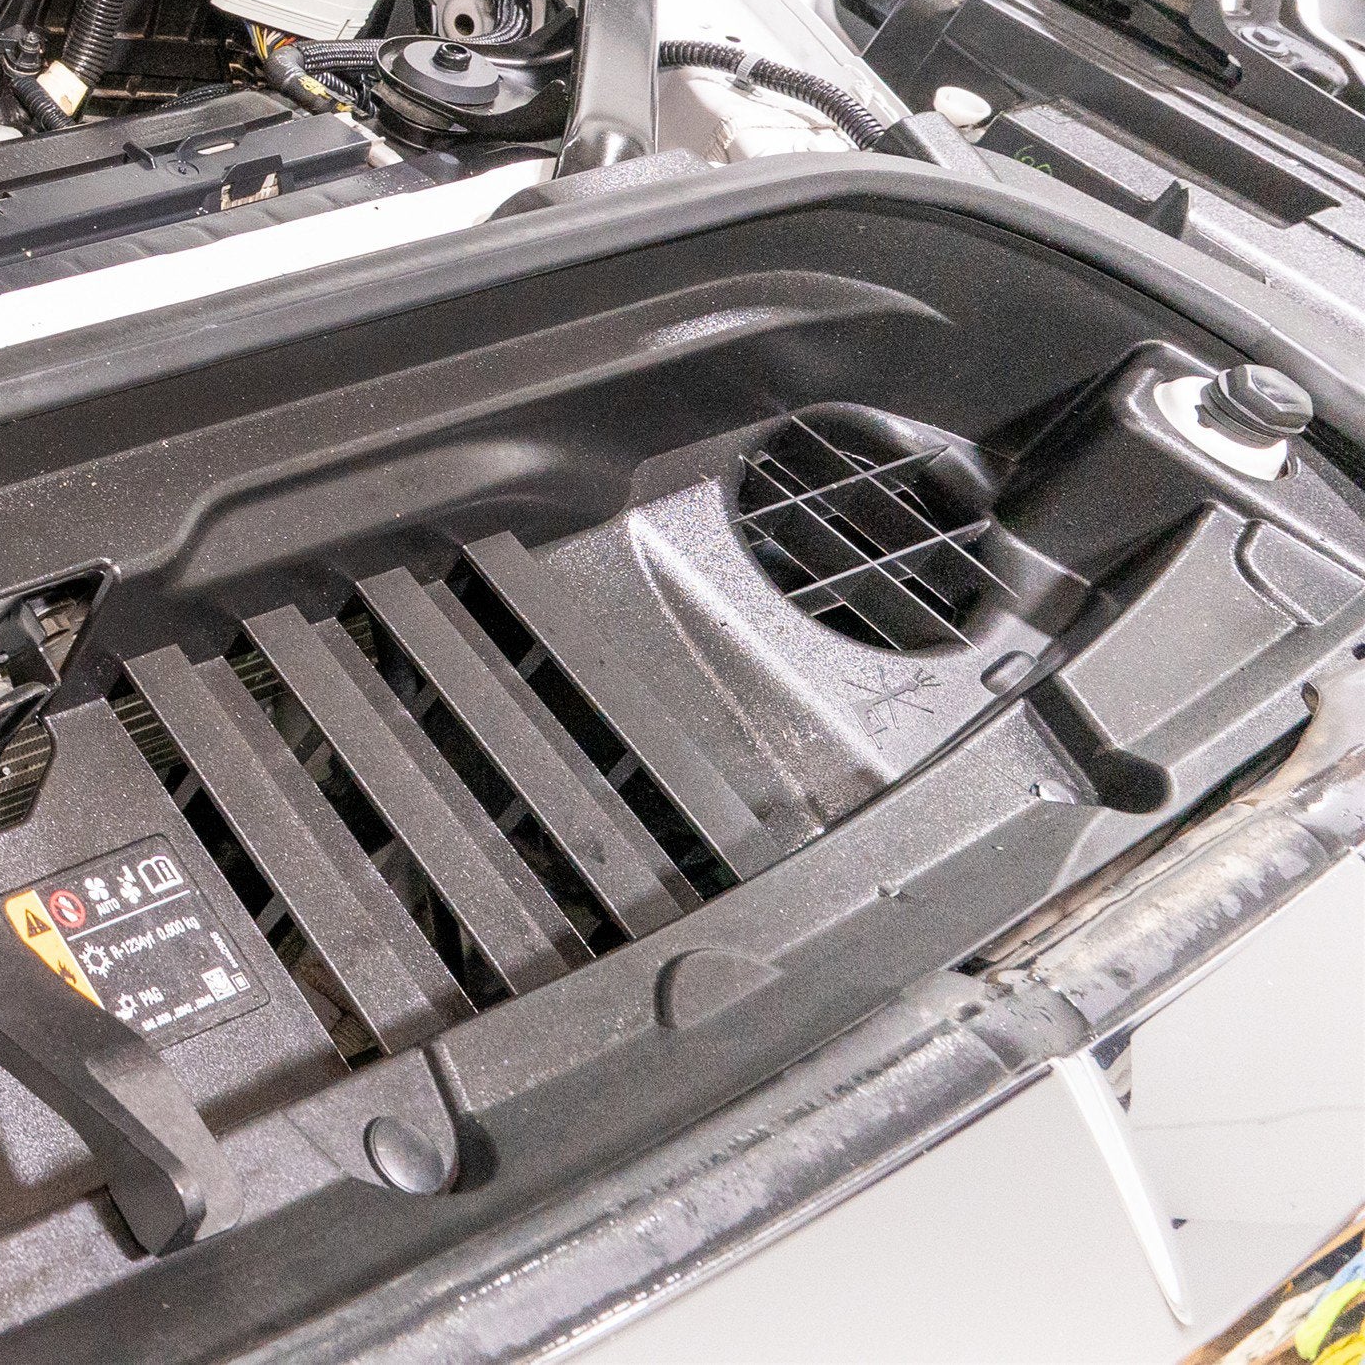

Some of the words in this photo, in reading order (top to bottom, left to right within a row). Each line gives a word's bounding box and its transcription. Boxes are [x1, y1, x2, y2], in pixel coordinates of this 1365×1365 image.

[95, 897, 121, 916] AUTO
[109, 931, 156, 961] R-1234yf
[181, 916, 201, 930] kg
[138, 986, 165, 1008] PAG
